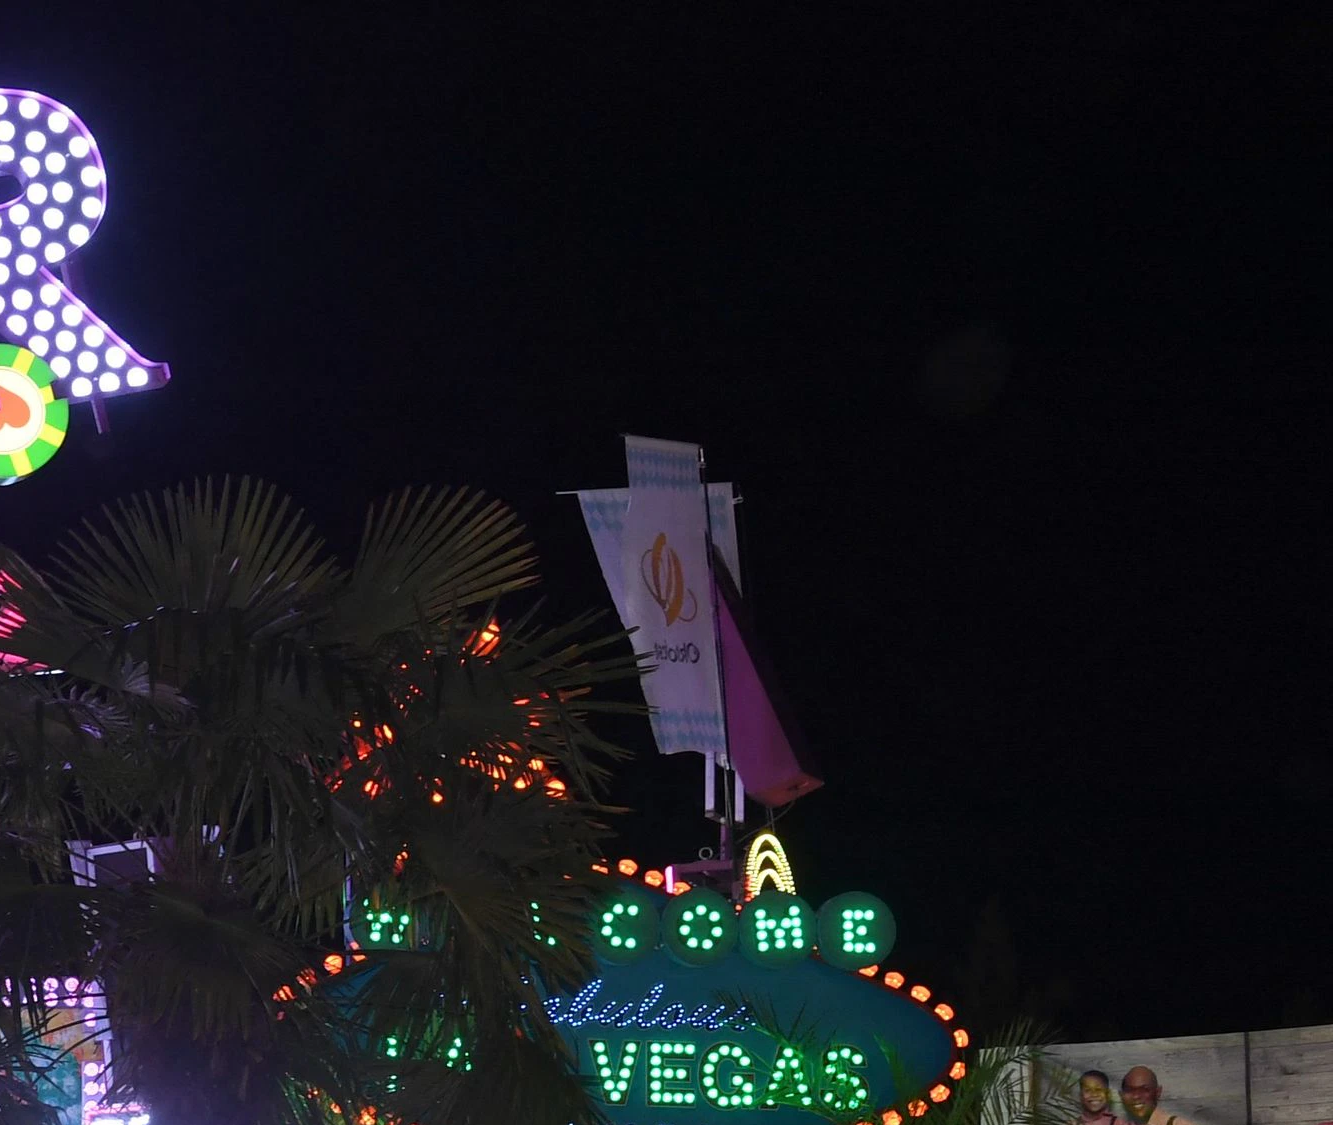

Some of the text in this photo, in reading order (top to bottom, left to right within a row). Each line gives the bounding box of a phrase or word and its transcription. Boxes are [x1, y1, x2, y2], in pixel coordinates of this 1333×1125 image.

[363, 900, 878, 957] WCOME
[538, 978, 758, 1031] abulous
[588, 1037, 869, 1112] VEGAS
